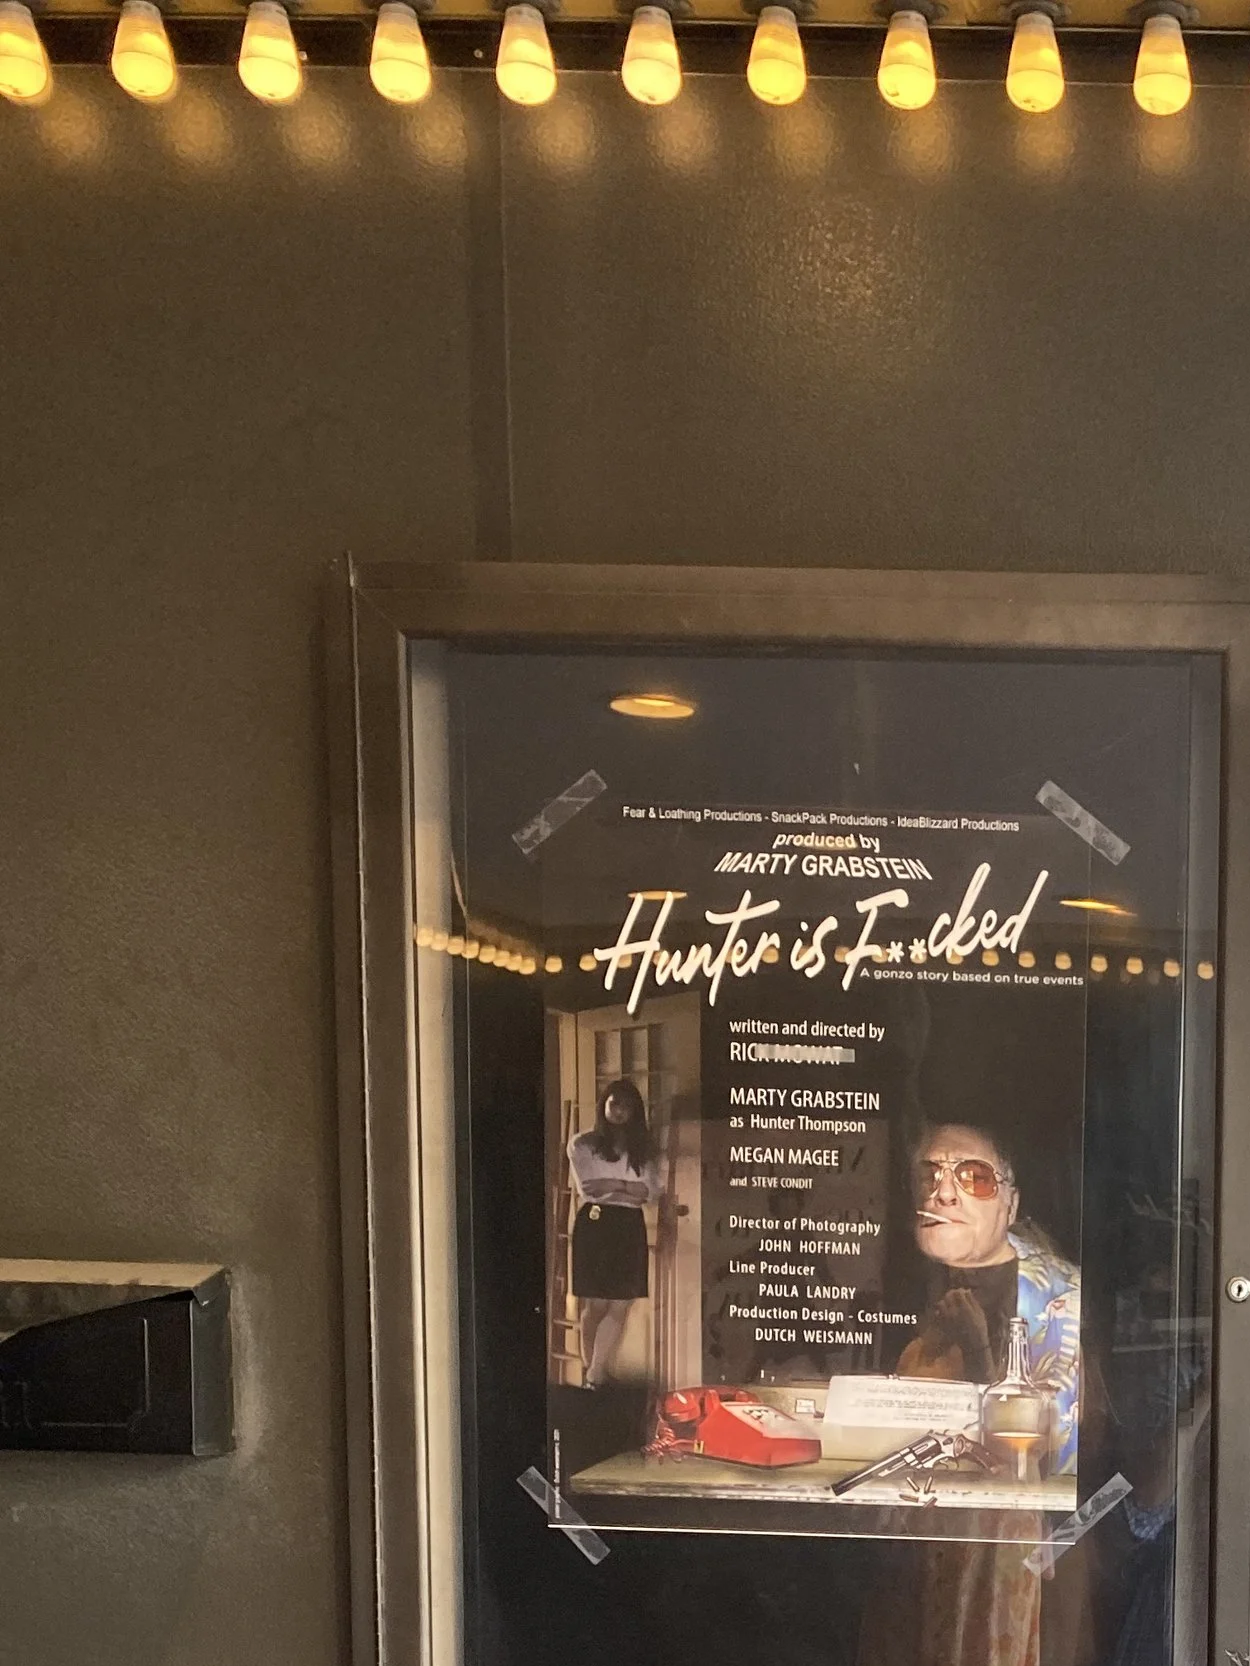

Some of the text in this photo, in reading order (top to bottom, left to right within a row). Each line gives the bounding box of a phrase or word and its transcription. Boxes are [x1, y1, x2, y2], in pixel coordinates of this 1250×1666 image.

[622, 806, 646, 819] Fear
[649, 807, 656, 819] &
[659, 808, 701, 822] Loathing
[703, 809, 762, 822] Productions
[771, 811, 828, 825] SnackPack
[830, 812, 888, 828] Productions
[897, 815, 959, 830] IdeaBlizzard
[960, 817, 1020, 832] Productions
[772, 832, 880, 853] produced by
[713, 851, 934, 881] MARTY GRABSTEIN
[593, 889, 781, 1014] Hunter
[790, 915, 839, 978] is
[859, 967, 1084, 986] A gonzo story based on true events
[729, 1019, 886, 1042] written and directed by
[730, 1042, 770, 1062] RIC
[730, 1087, 881, 1111] MARTY GRABSTEIN
[729, 1114, 867, 1136] as Hunter Thompson
[729, 1147, 840, 1167] MEGAN MAGEE
[729, 1176, 814, 1190] and STEVE CONDIT
[729, 1216, 882, 1237] Director of Photography
[758, 1239, 861, 1256] JOHN HOFFMAN
[729, 1261, 816, 1277] Line Producer
[758, 1284, 857, 1301] PAULA LANDRY
[729, 1305, 798, 1321] Production
[801, 1307, 845, 1324] Design
[857, 1309, 918, 1326] Costumes
[754, 1328, 874, 1346] DUTCH WEISMANN
